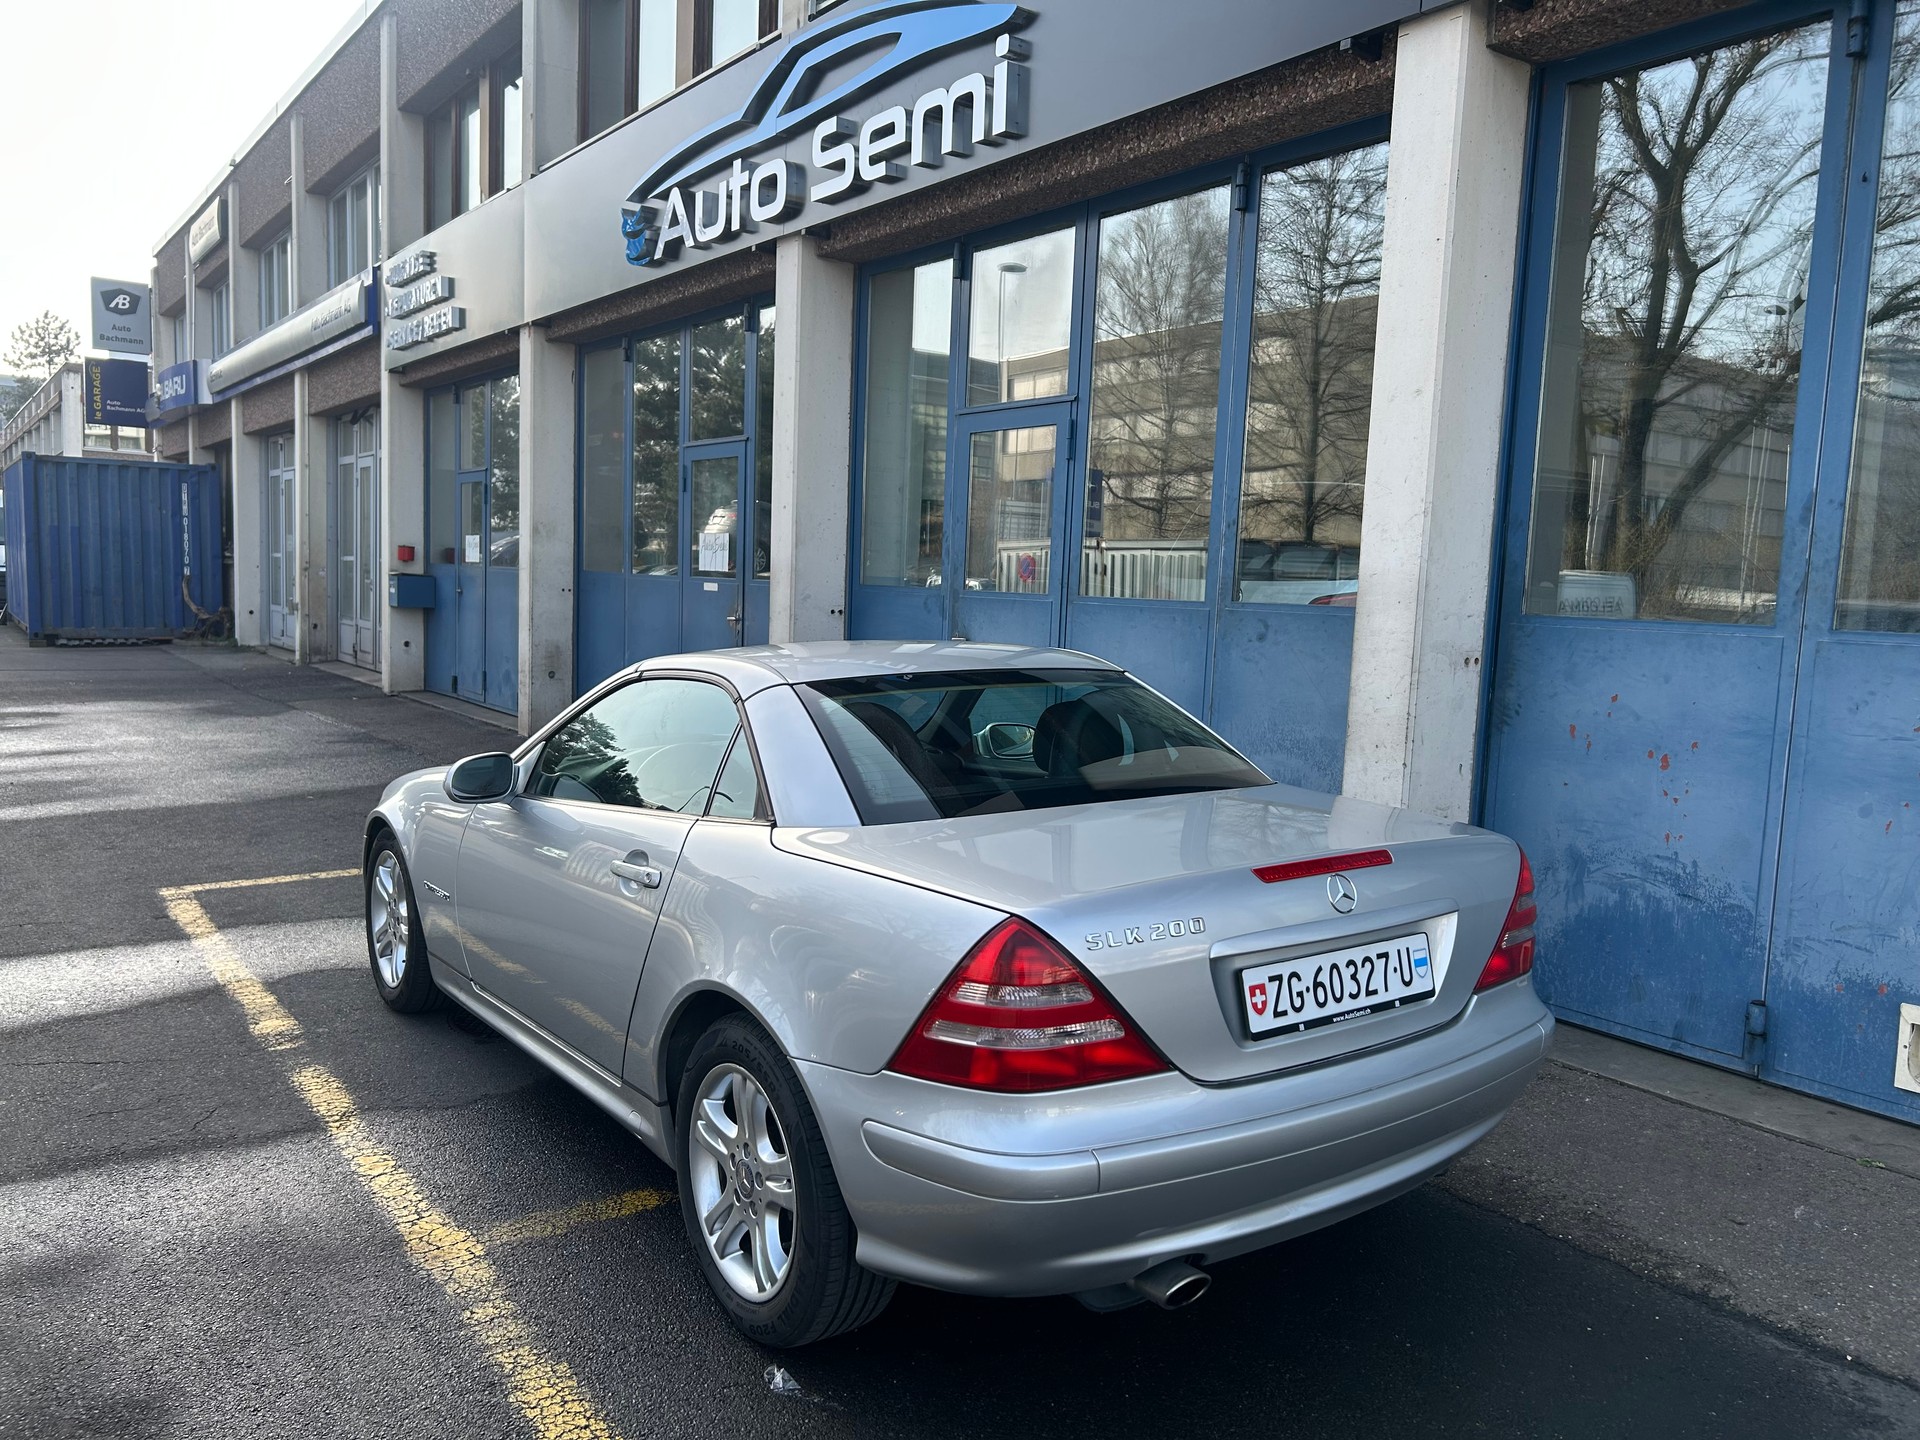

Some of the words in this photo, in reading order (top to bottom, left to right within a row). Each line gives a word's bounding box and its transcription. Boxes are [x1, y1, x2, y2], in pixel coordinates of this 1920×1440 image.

[653, 157, 788, 260] Auto
[810, 33, 1012, 202] Semi
[111, 323, 131, 333] Auto
[99, 333, 144, 345] Bachmann
[92, 366, 102, 410] GARAGE
[158, 374, 186, 401] UBARU
[106, 405, 136, 413] Bachmann
[1084, 926, 1144, 951] SLK
[1149, 916, 1206, 941] 200
[1332, 1007, 1371, 1022] www.AutoSemi.ch
